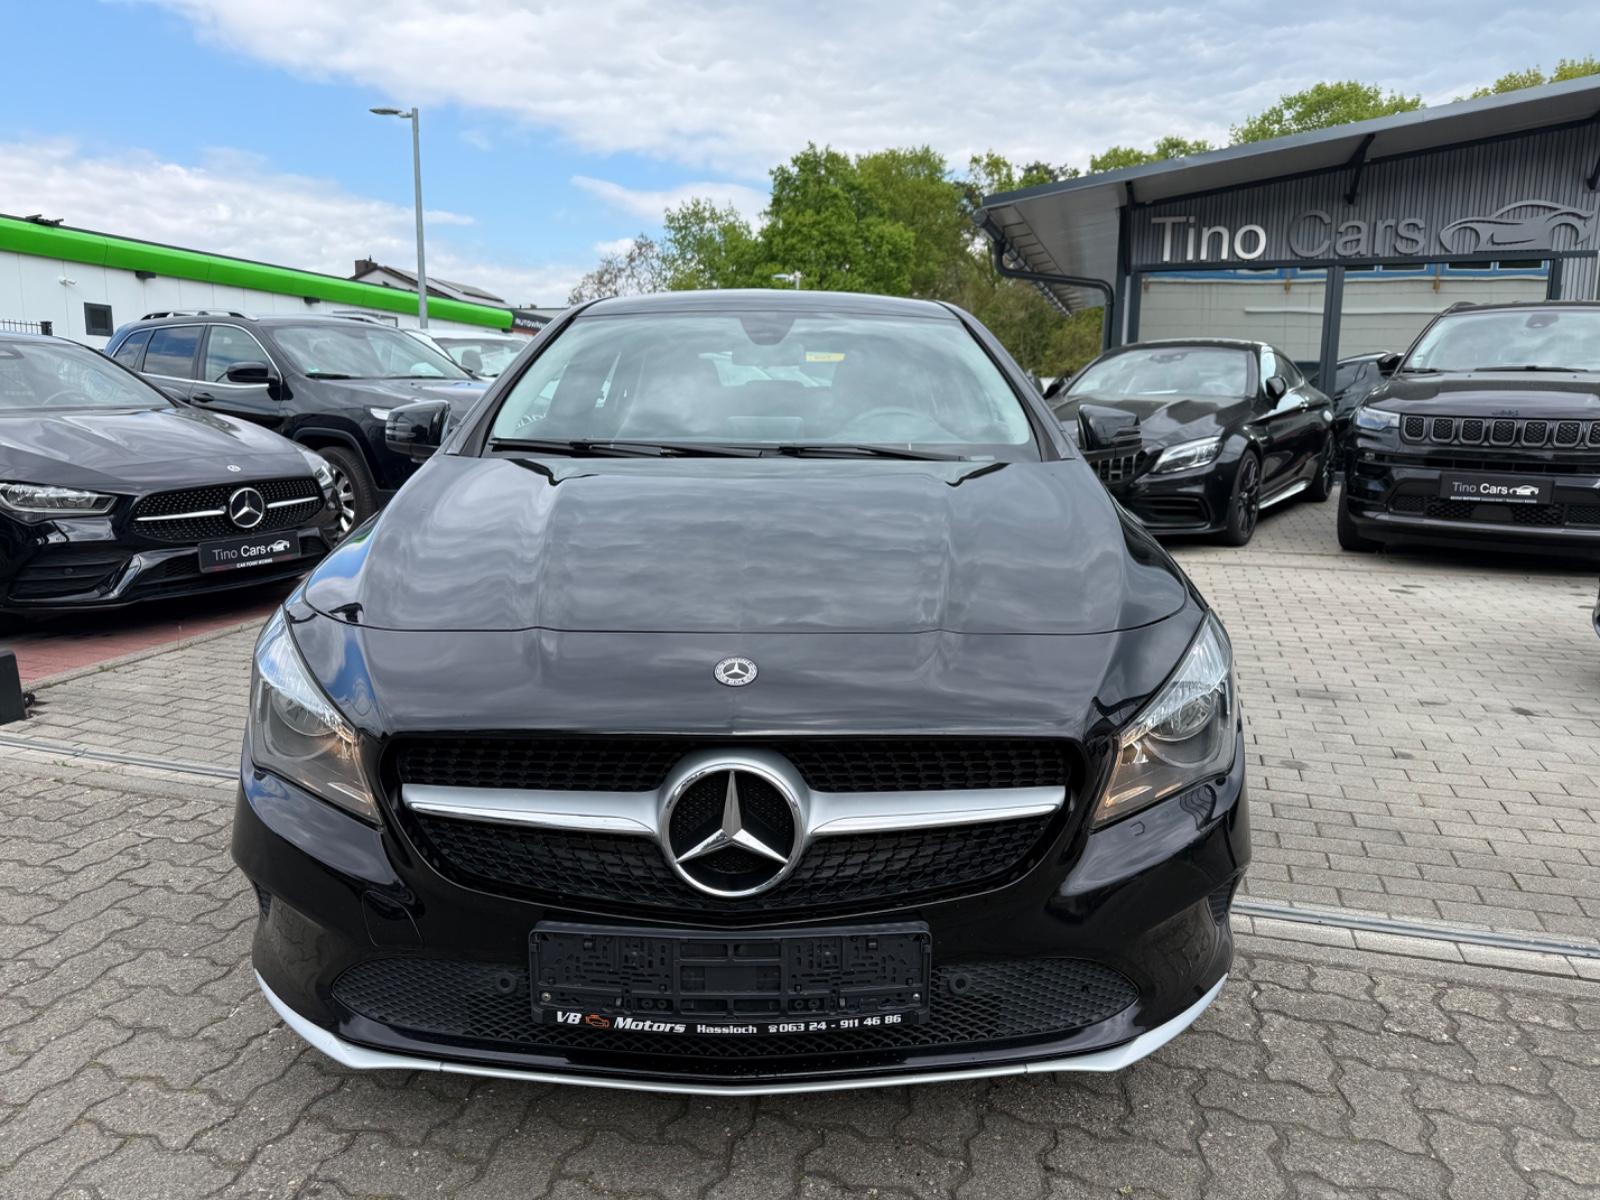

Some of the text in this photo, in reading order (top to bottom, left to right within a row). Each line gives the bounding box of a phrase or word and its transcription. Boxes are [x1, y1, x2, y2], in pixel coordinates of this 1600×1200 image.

[1151, 209, 1427, 262] Tino Cars
[1452, 482, 1508, 495] Tino Cars
[212, 545, 266, 560] Tino Cars
[556, 1011, 582, 1024] VB
[614, 1016, 686, 1033] Motors
[696, 1024, 758, 1034] Hassloch
[779, 1023, 805, 1033] 063
[808, 1021, 827, 1031] 24
[840, 1019, 859, 1028] 911
[863, 1016, 881, 1026] 46
[884, 1014, 902, 1024] 86
